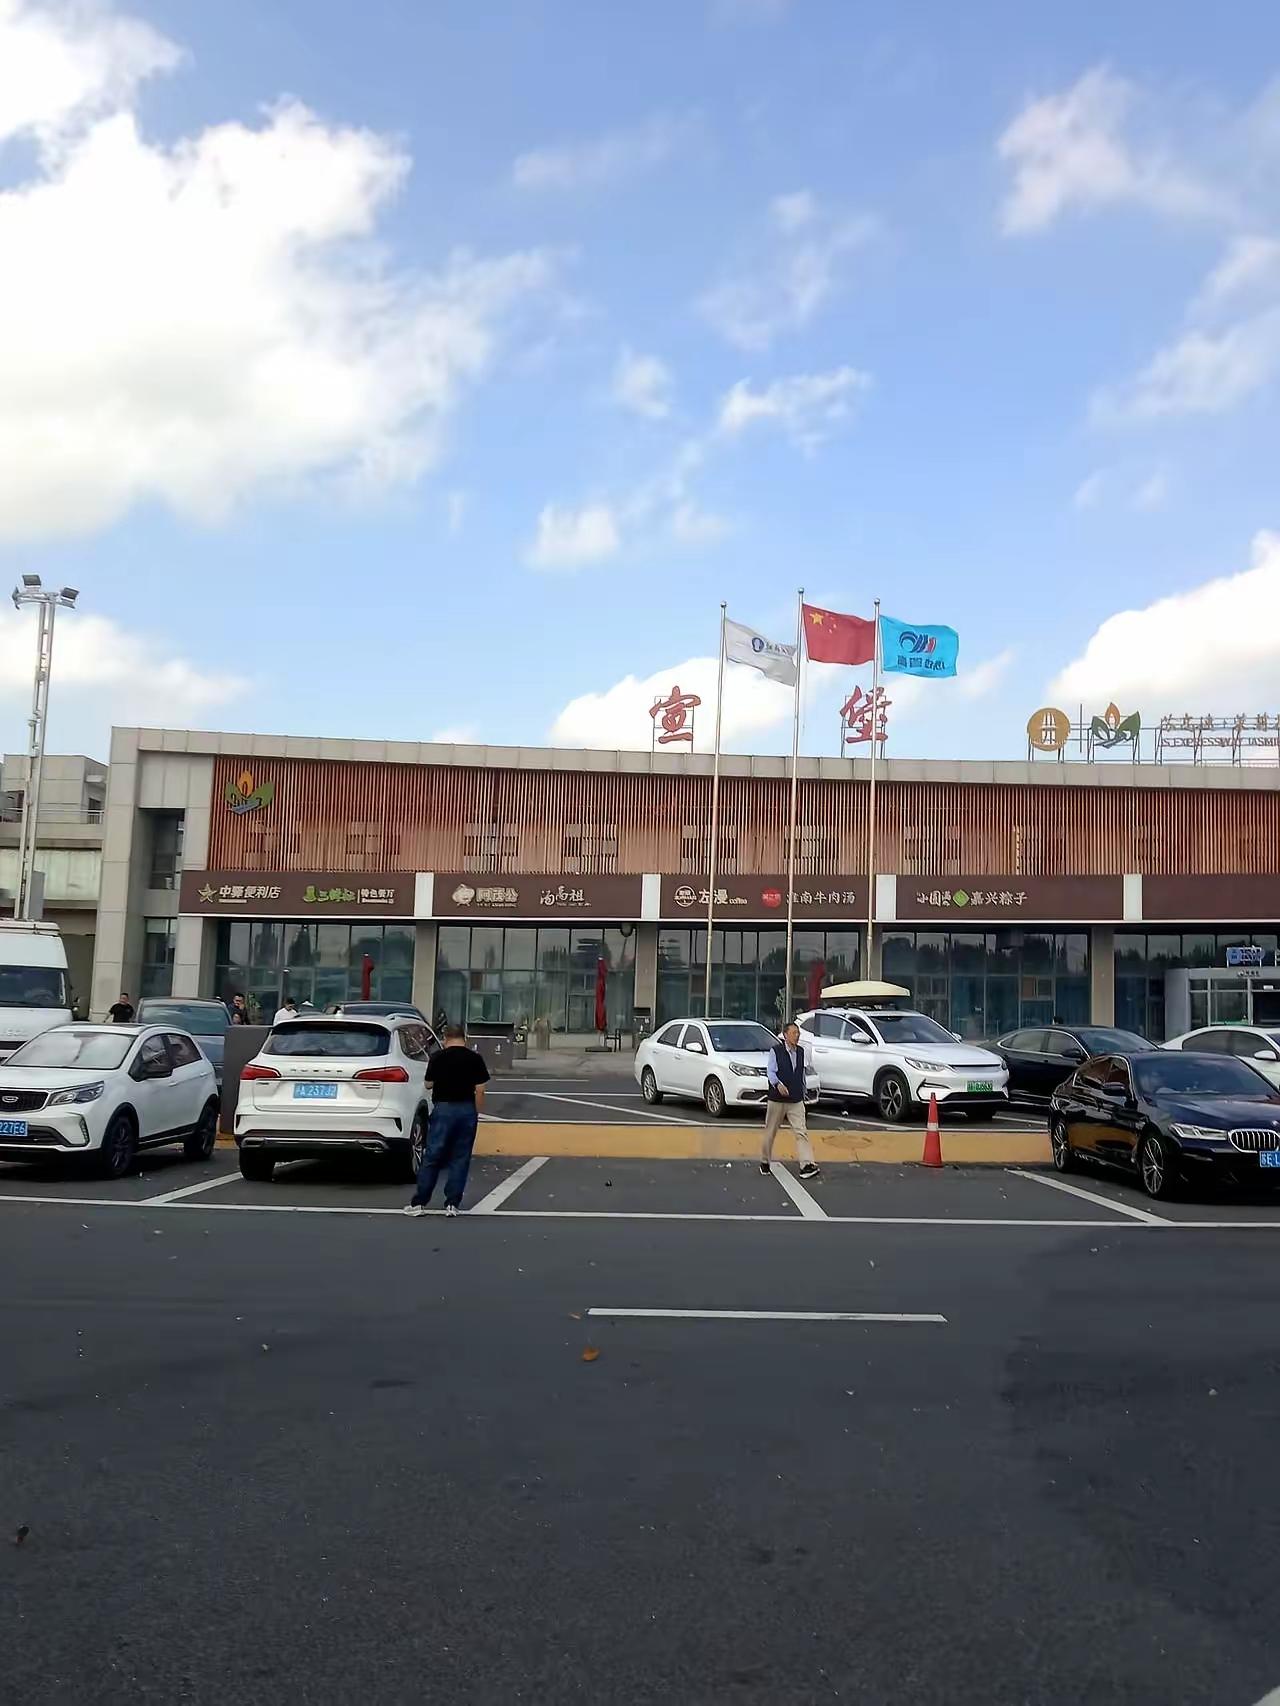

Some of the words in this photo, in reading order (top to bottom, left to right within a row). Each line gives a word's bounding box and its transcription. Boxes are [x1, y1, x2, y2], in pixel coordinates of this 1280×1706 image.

[649, 686, 701, 744] 宣
[971, 890, 1027, 906] 嘉兴粽子
